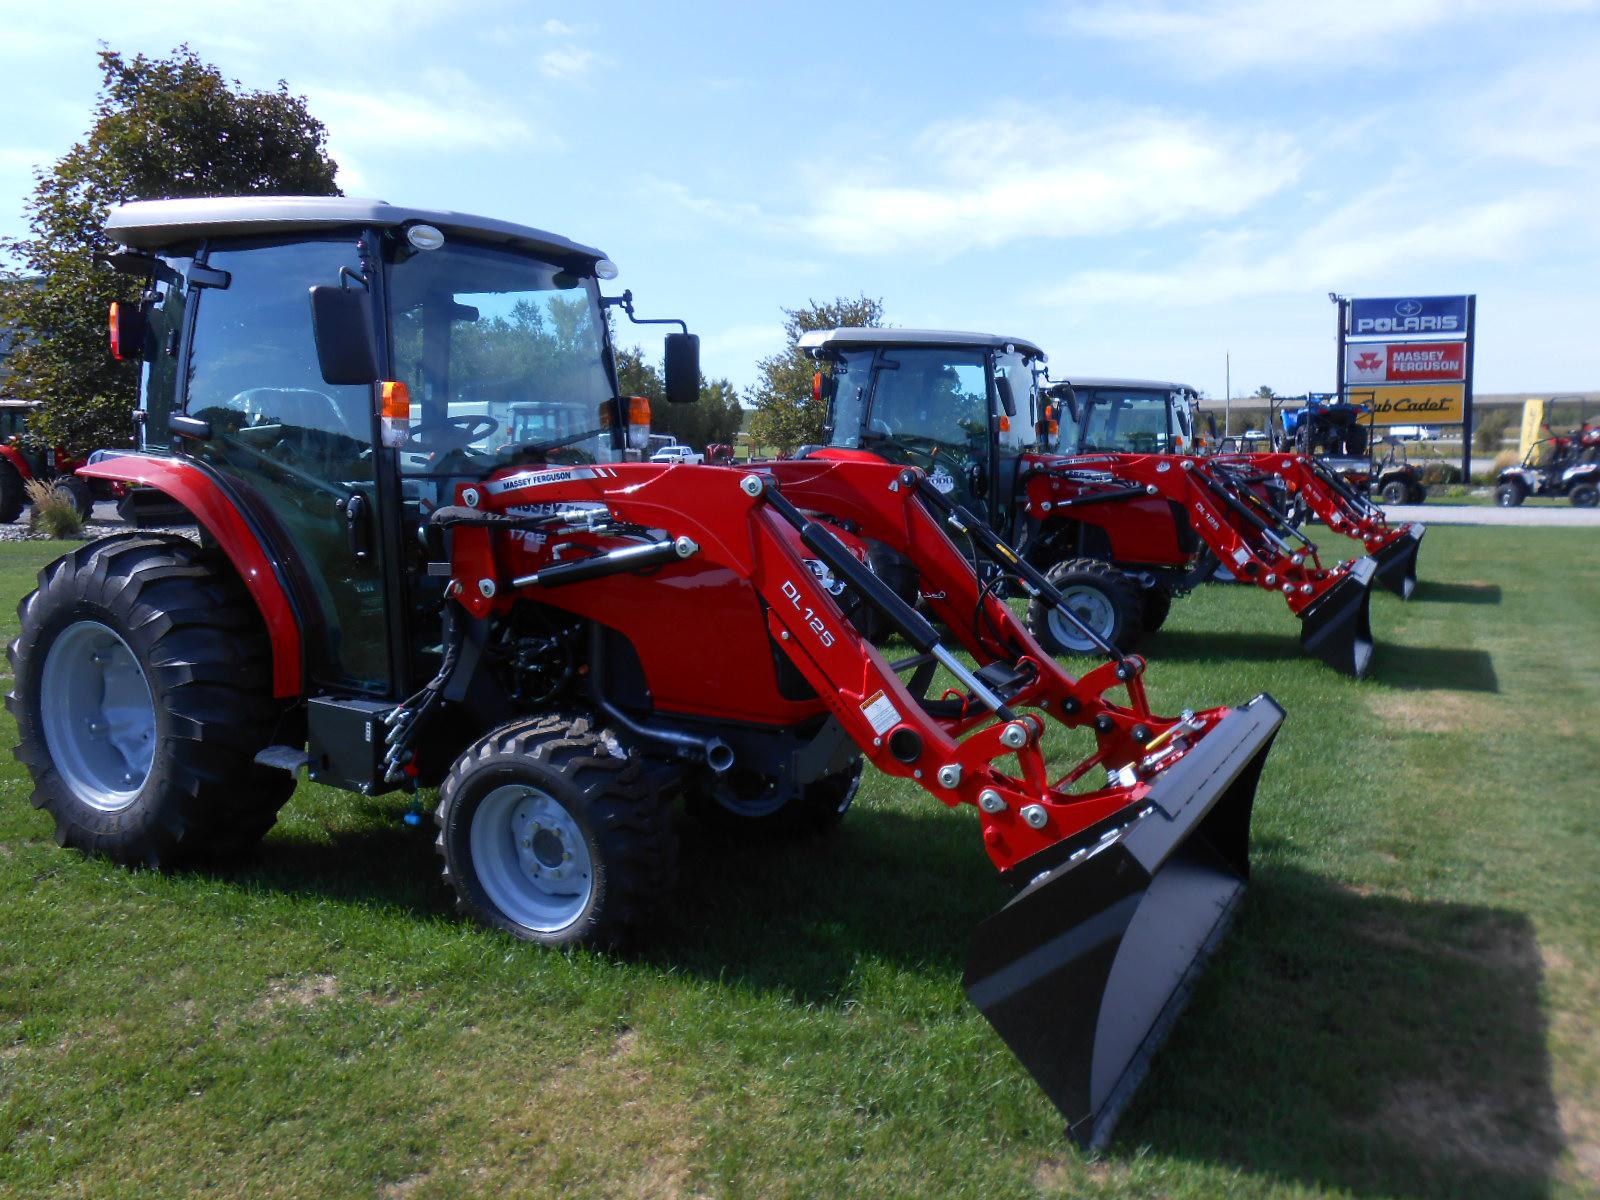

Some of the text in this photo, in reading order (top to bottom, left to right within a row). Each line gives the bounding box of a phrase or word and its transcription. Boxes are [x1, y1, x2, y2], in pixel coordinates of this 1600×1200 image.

[1357, 315, 1458, 332] POLARIS
[1392, 351, 1445, 362] MASSEY
[1392, 361, 1459, 371] FERGUSON
[1394, 398, 1453, 412] Cadet
[503, 471, 571, 490] MASSEY FERGUSON
